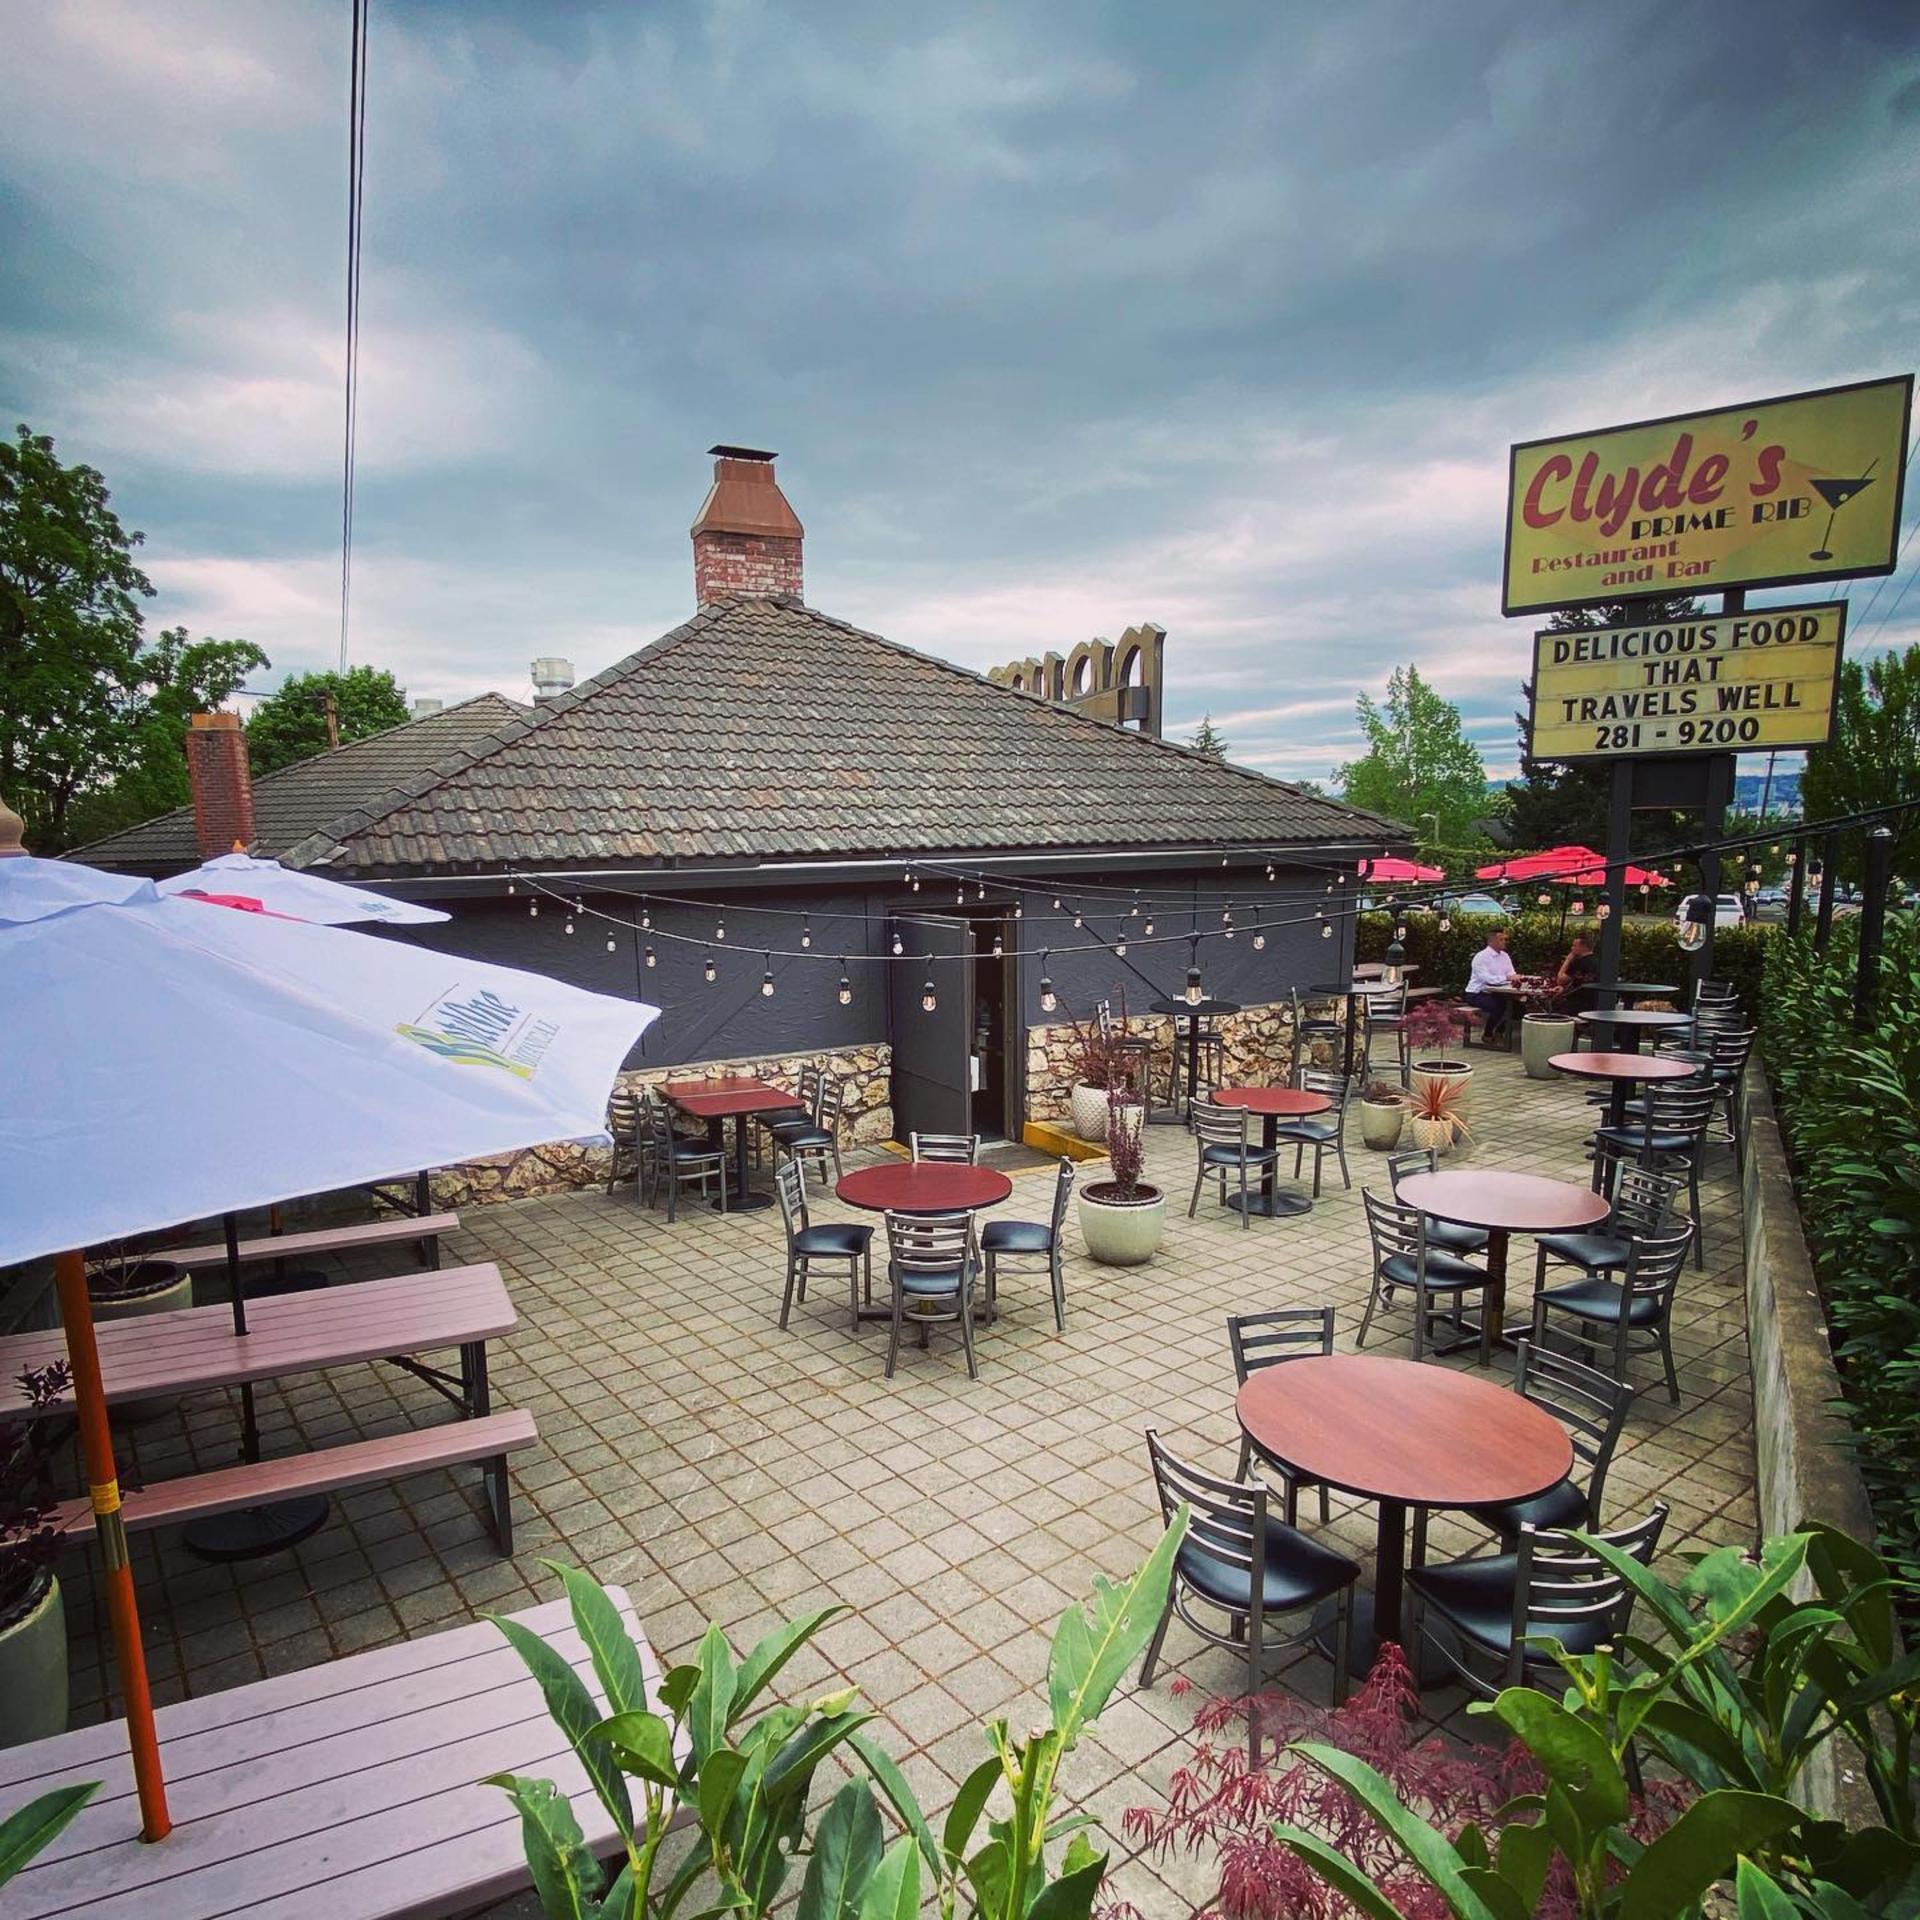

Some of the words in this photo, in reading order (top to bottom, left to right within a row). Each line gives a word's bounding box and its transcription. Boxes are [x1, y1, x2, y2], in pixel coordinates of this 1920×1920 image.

[1523, 419, 1786, 538] Clyde's
[1631, 507, 1736, 540] PRIME
[1752, 497, 1812, 524] RIB
[1532, 540, 1680, 574] Restaurant
[1601, 563, 1653, 587] and
[1667, 559, 1717, 579] Bar
[1554, 625, 1717, 663] DELICIOUS
[1732, 616, 1819, 648] FOOD
[1643, 656, 1723, 686] THAT
[1562, 689, 1697, 722] TRAVELS
[1717, 682, 1800, 712] WELL
[1595, 724, 1640, 750] 281
[1679, 717, 1759, 745] 9200
